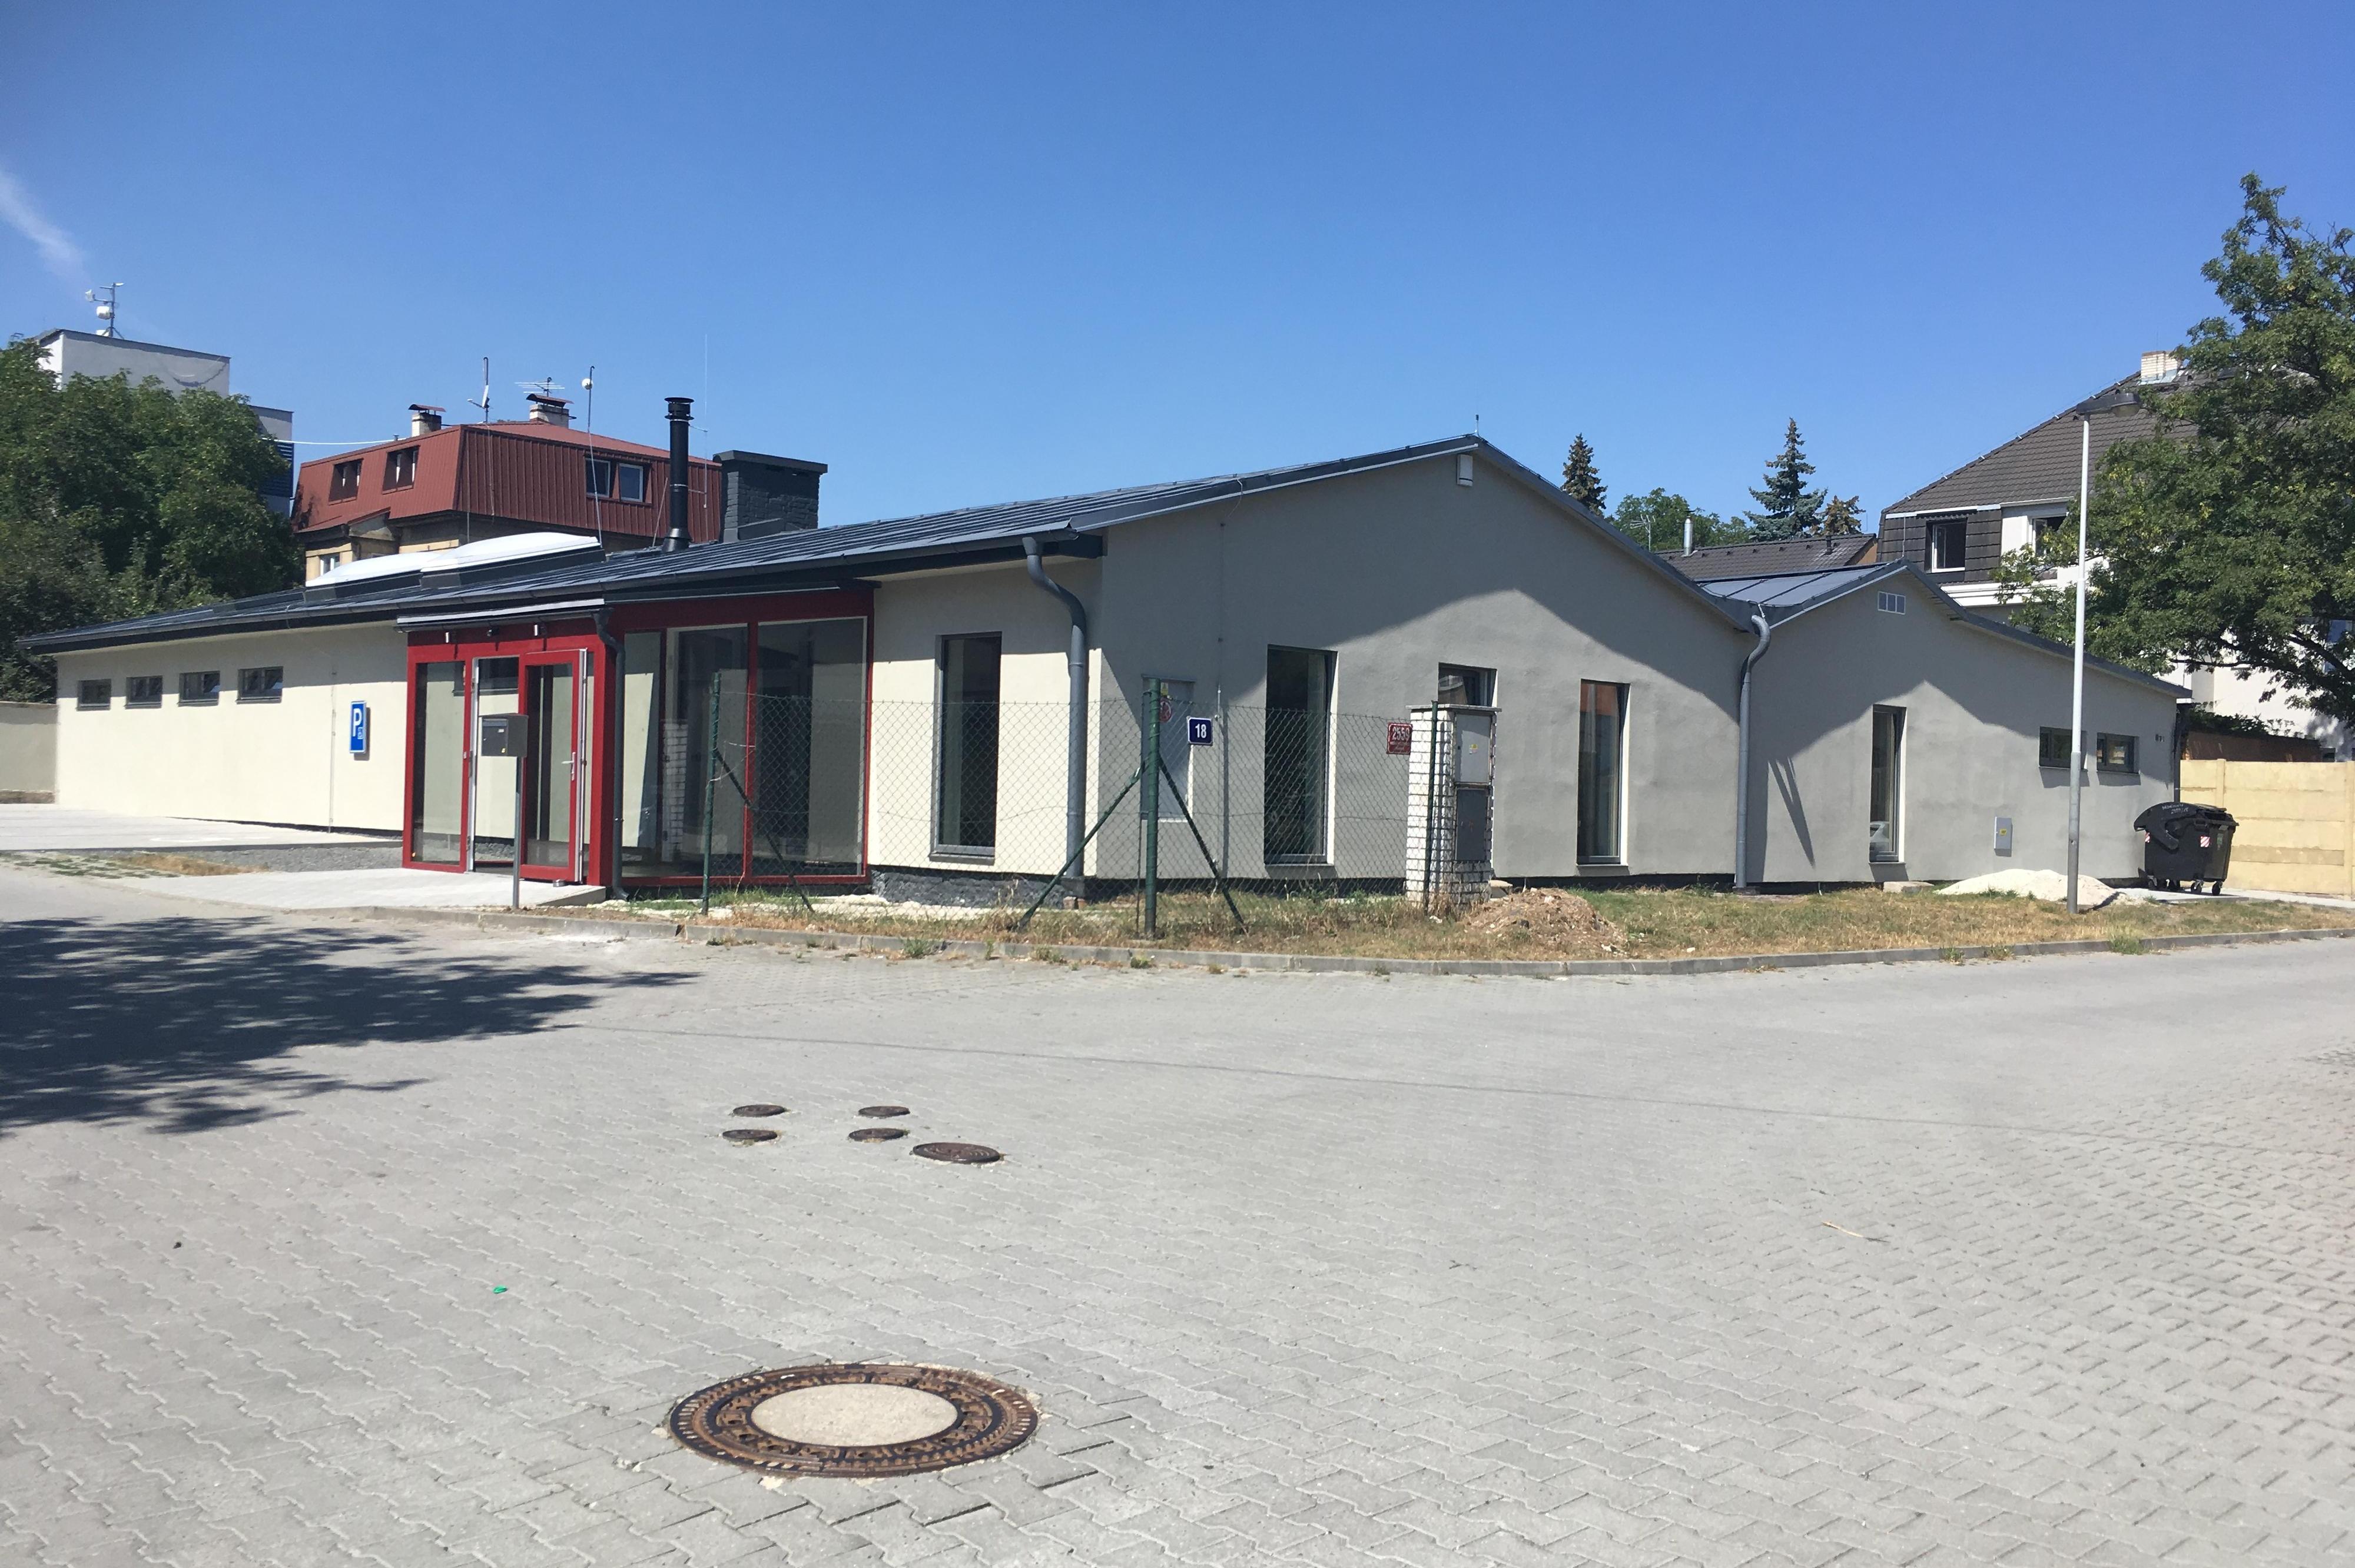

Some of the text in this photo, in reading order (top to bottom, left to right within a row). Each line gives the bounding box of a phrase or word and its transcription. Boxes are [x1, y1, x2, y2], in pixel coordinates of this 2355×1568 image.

[353, 708, 362, 736] P
[1195, 723, 1207, 739] 18
[1392, 726, 1410, 742] 2559
